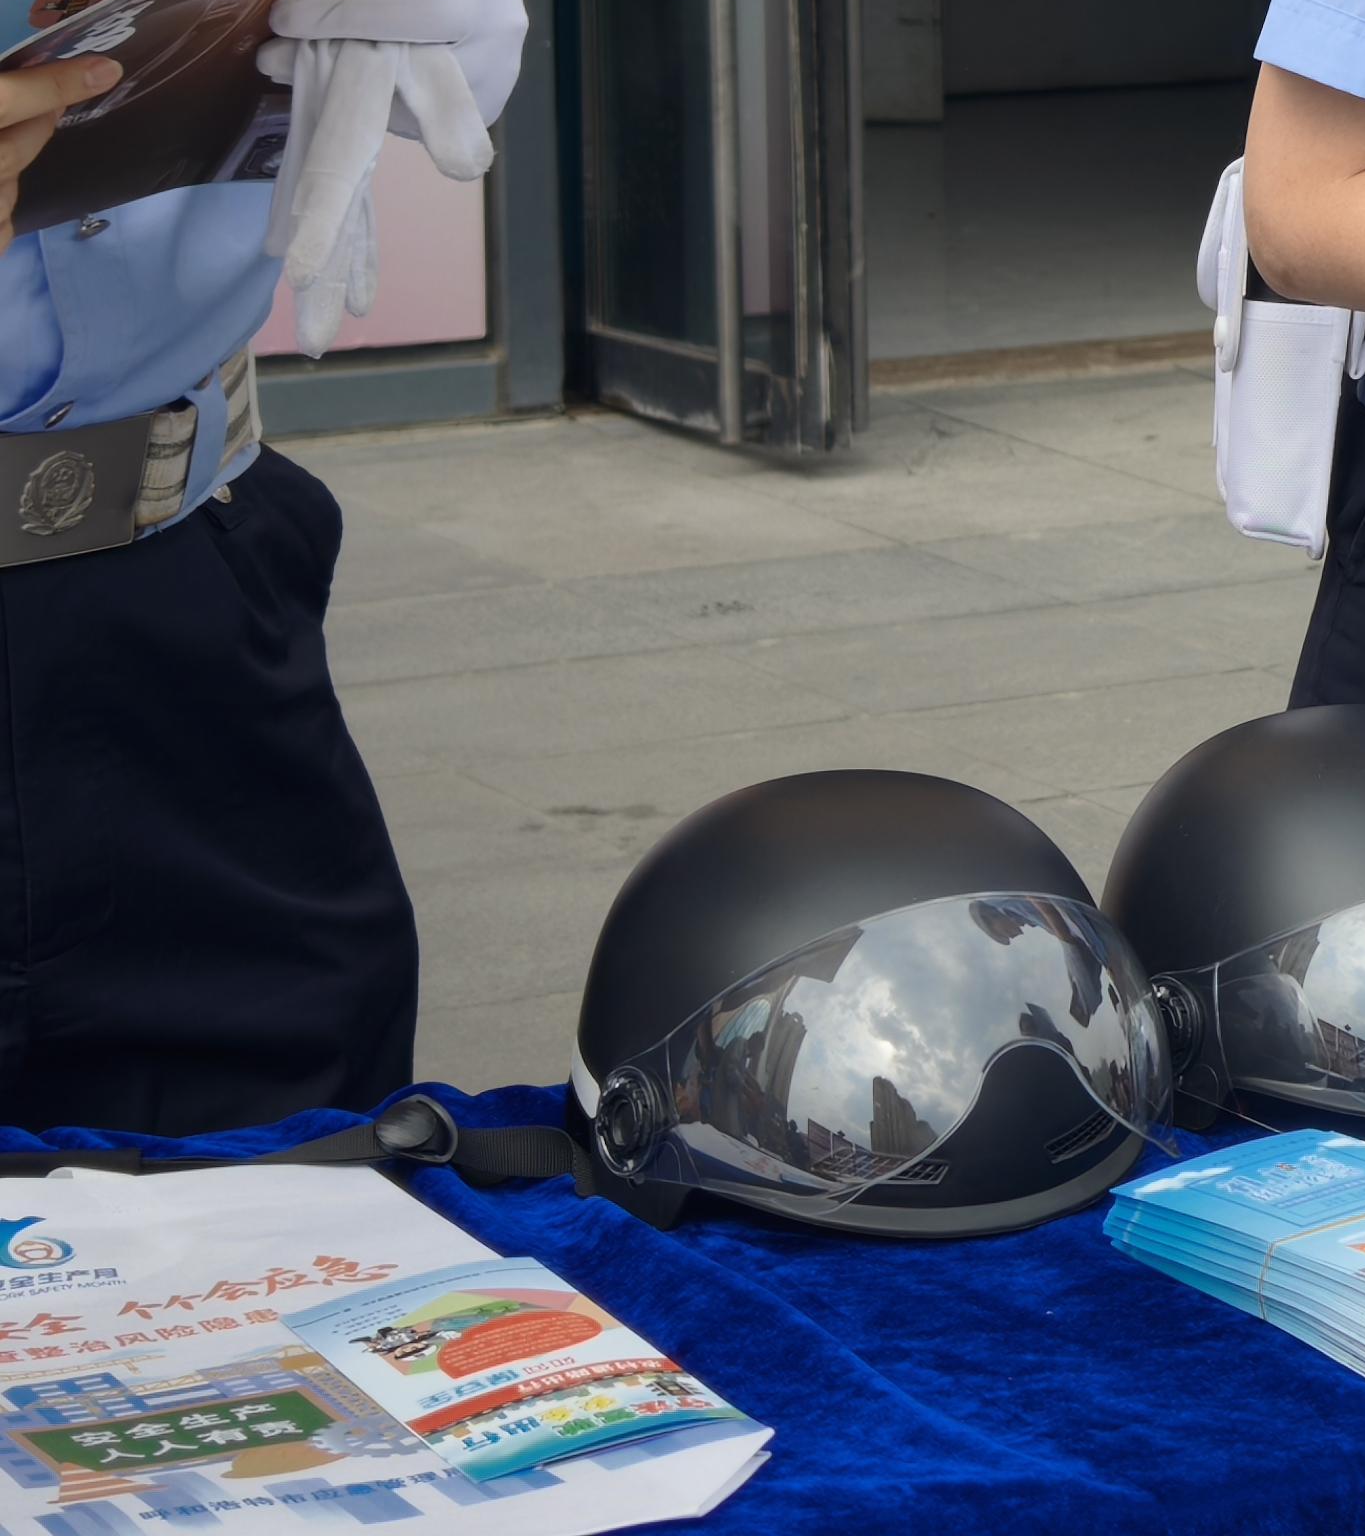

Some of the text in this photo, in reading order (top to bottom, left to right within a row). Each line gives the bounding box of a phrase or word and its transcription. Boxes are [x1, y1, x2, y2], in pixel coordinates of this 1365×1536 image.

[0, 1267, 119, 1292] 全生产月
[117, 1255, 399, 1321] 个个会应急
[69, 1401, 278, 1449] 安全生产
[100, 1417, 304, 1465] 人人有责
